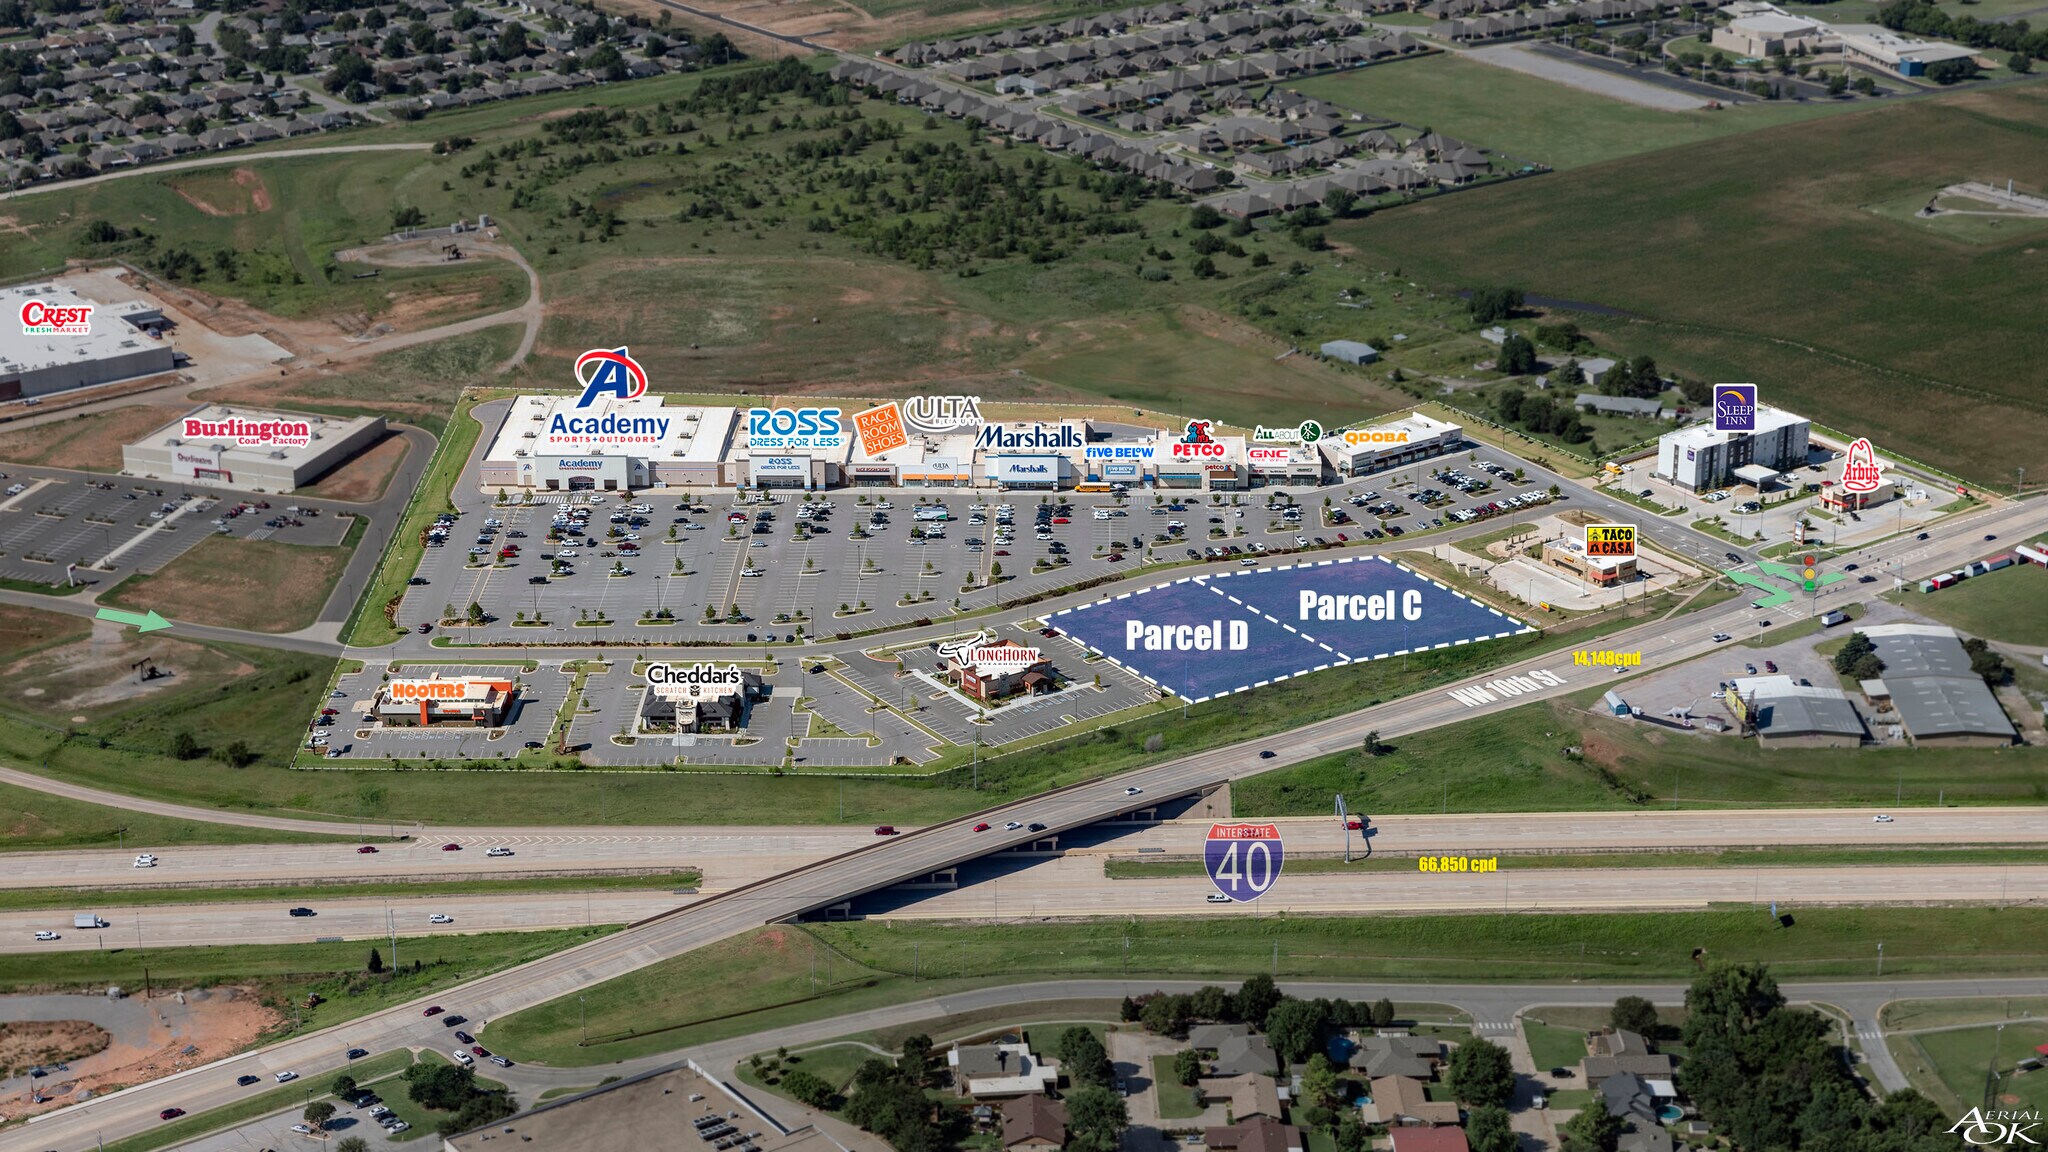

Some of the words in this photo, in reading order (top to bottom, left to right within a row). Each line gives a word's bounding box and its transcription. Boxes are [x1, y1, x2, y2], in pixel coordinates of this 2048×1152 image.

[558, 459, 603, 469] Academy
[768, 457, 793, 465] ROSS
[1008, 464, 1048, 473] Marshalls
